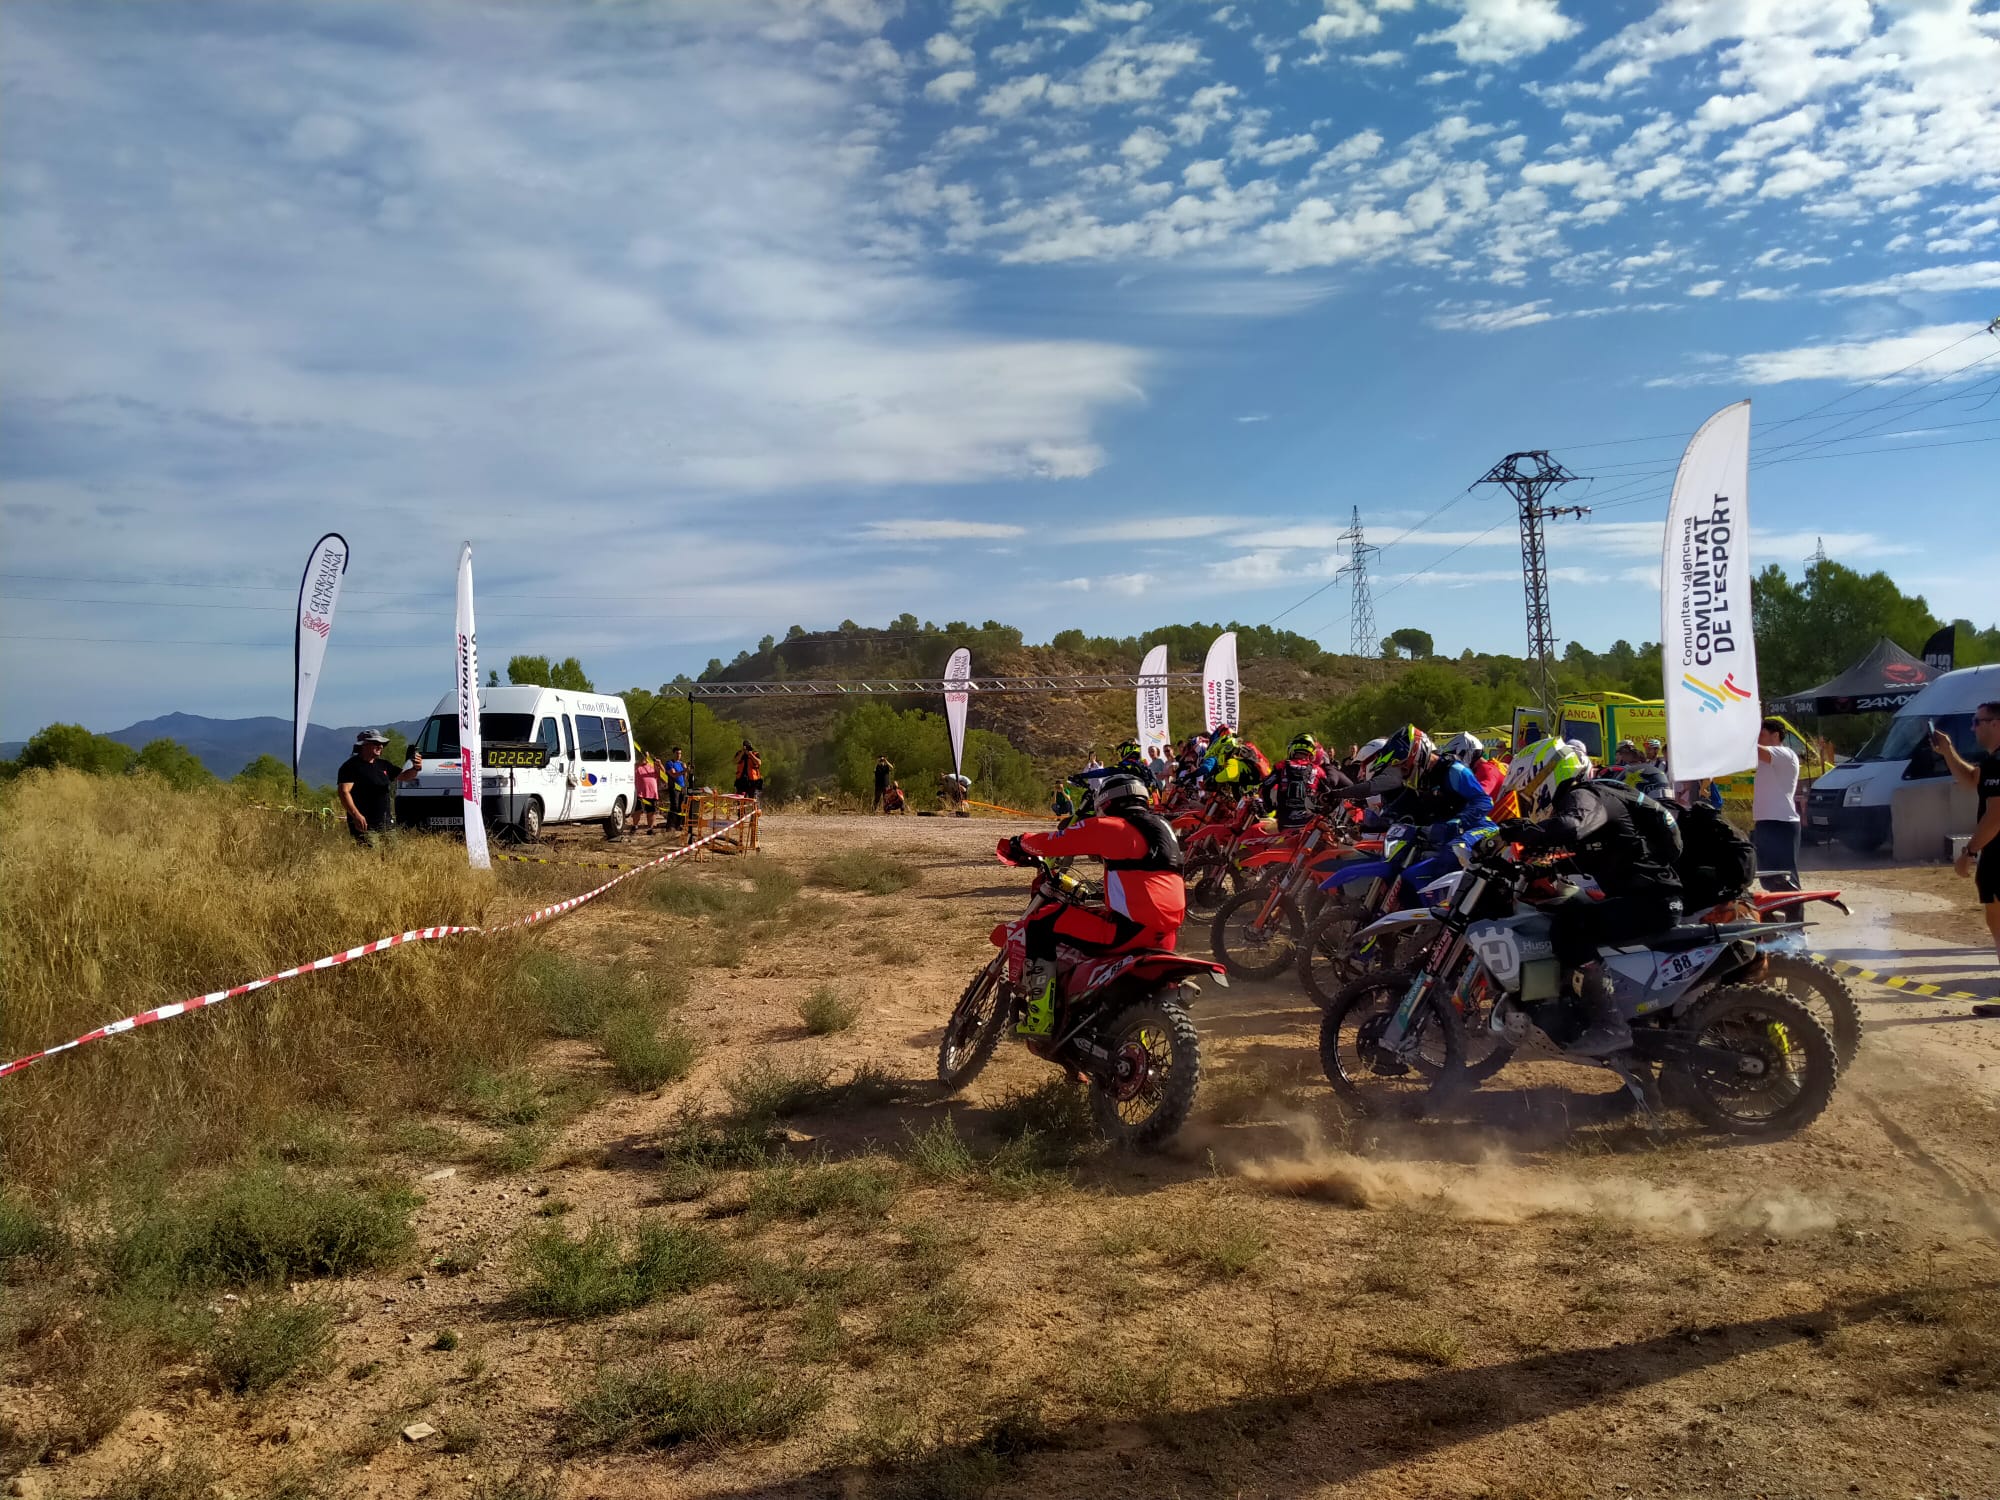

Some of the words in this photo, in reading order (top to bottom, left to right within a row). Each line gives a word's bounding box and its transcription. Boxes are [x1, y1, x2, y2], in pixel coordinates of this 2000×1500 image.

[1711, 494, 1730, 612] L'ESPORT
[309, 548, 335, 613] GENERALITAT
[319, 553, 344, 615] VALENCIANA
[1693, 516, 1712, 666] COMUNITAT
[1681, 594, 1692, 666] Comunitat
[1713, 620, 1735, 654] DE
[1155, 713, 1163, 725] DE
[1567, 709, 1597, 720] ANCIA
[1856, 693, 1915, 709] 24MX
[1672, 954, 1692, 973] 88
